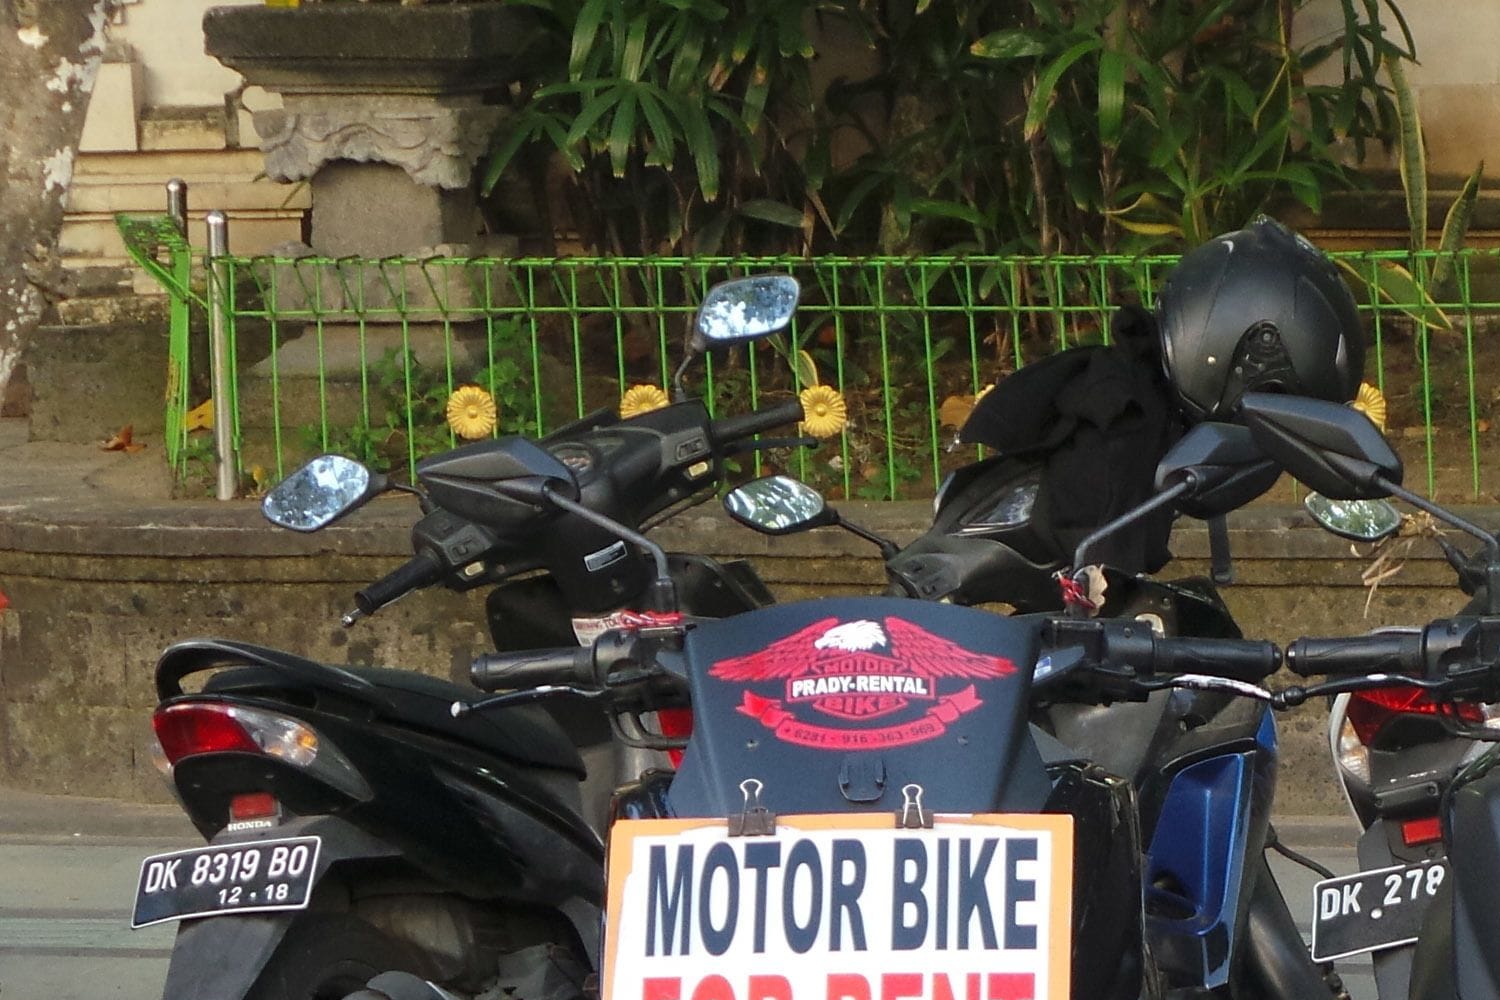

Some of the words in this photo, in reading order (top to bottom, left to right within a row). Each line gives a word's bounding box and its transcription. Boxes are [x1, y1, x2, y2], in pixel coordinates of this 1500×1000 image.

[824, 660, 896, 673] MOTOR
[792, 675, 928, 698] PRADY-RENTAL
[824, 697, 896, 715] BIKE
[227, 820, 272, 832] HONDA
[145, 859, 182, 893] DK
[191, 850, 261, 885] 8319
[645, 838, 868, 957] MOTOR
[891, 838, 1038, 951] BIKE
[1320, 882, 1363, 920] DK
